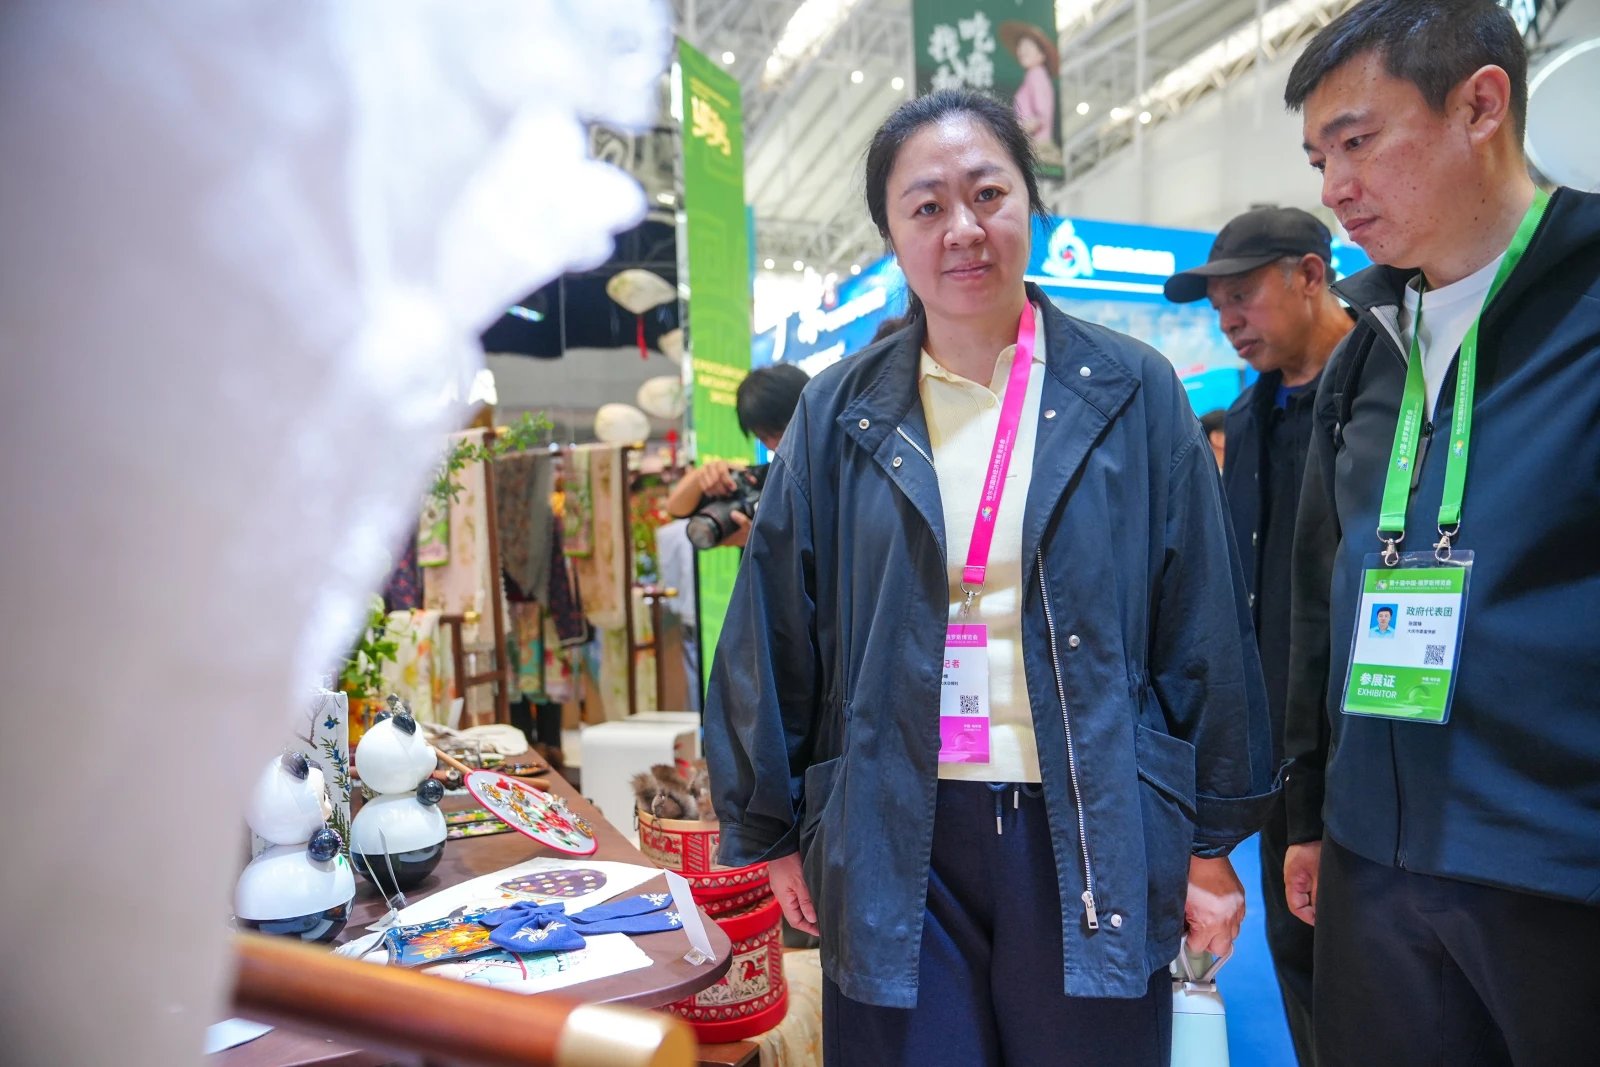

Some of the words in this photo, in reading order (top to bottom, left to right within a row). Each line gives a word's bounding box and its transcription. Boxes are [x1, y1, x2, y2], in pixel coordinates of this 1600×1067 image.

[1406, 606, 1453, 617] 政府代表团
[1359, 672, 1396, 688] 参展证
[1357, 687, 1398, 699] EXHIBITOR
